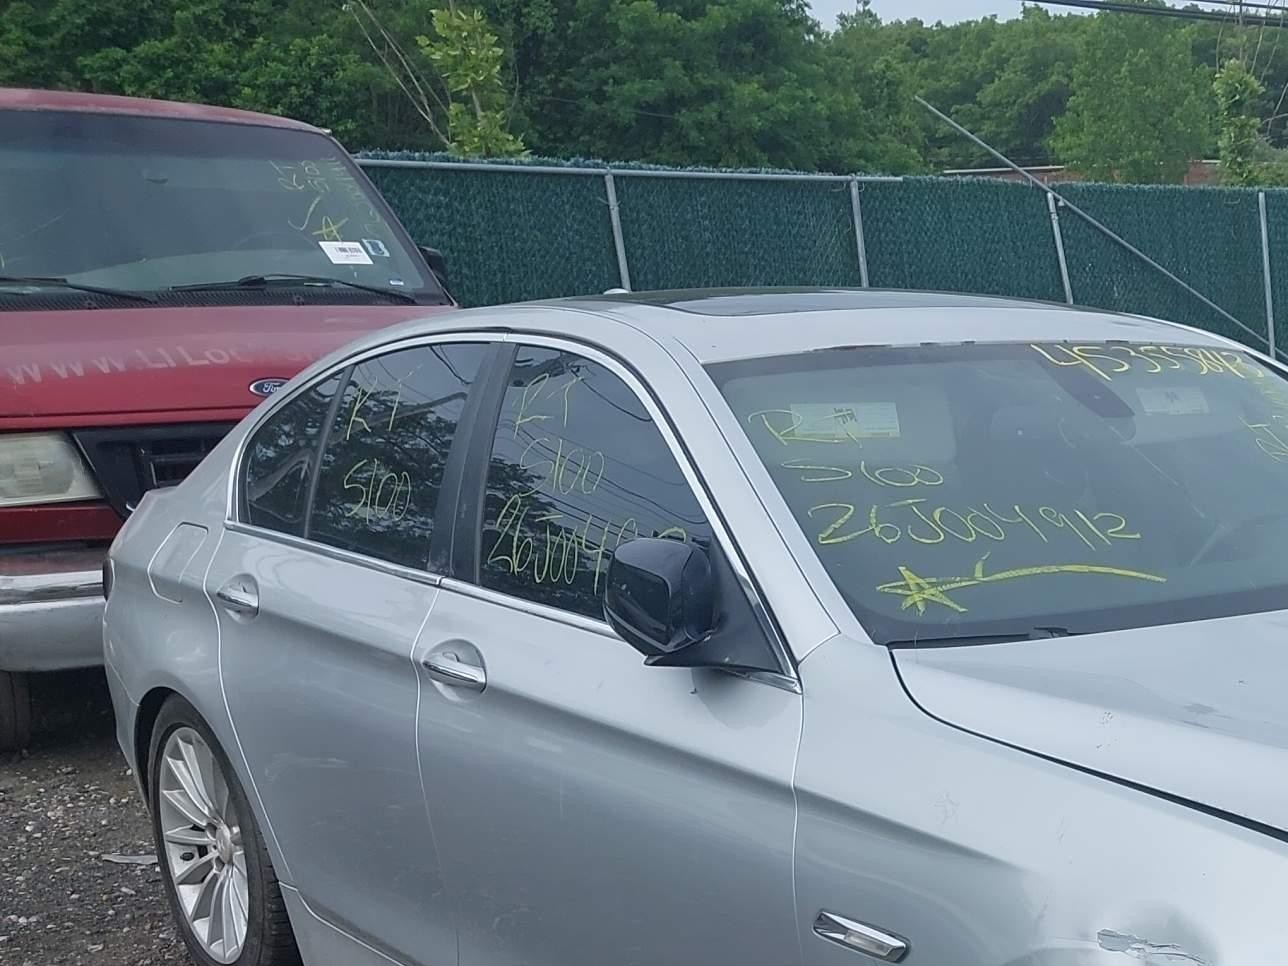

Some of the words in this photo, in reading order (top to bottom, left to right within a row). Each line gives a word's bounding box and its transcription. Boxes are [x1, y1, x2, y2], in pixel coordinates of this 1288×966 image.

[343, 458, 411, 525] S100
[519, 437, 605, 498] S100
[487, 494, 687, 596] 26J004
